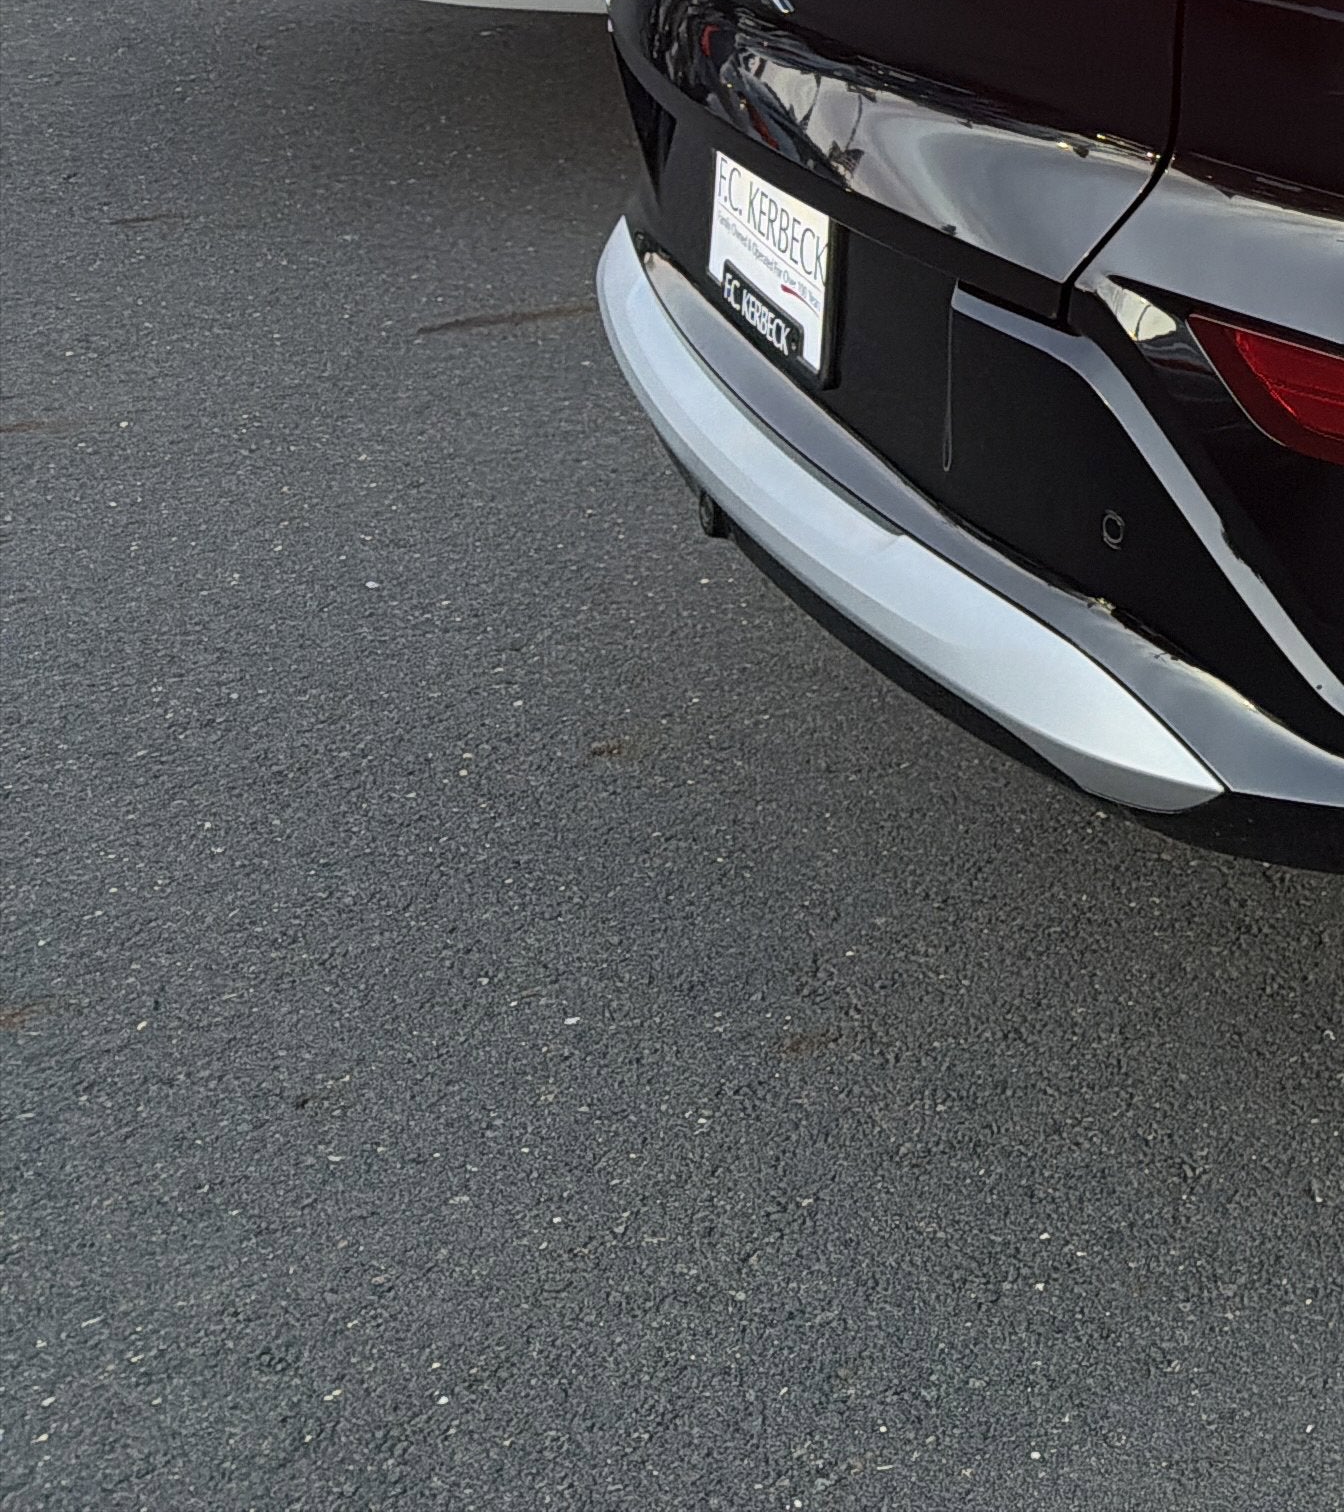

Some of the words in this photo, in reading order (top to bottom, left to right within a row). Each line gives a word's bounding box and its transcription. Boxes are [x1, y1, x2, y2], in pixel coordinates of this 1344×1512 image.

[718, 156, 743, 216] F.C.
[748, 186, 828, 286] KERBECK
[742, 288, 791, 357] KERBECK
